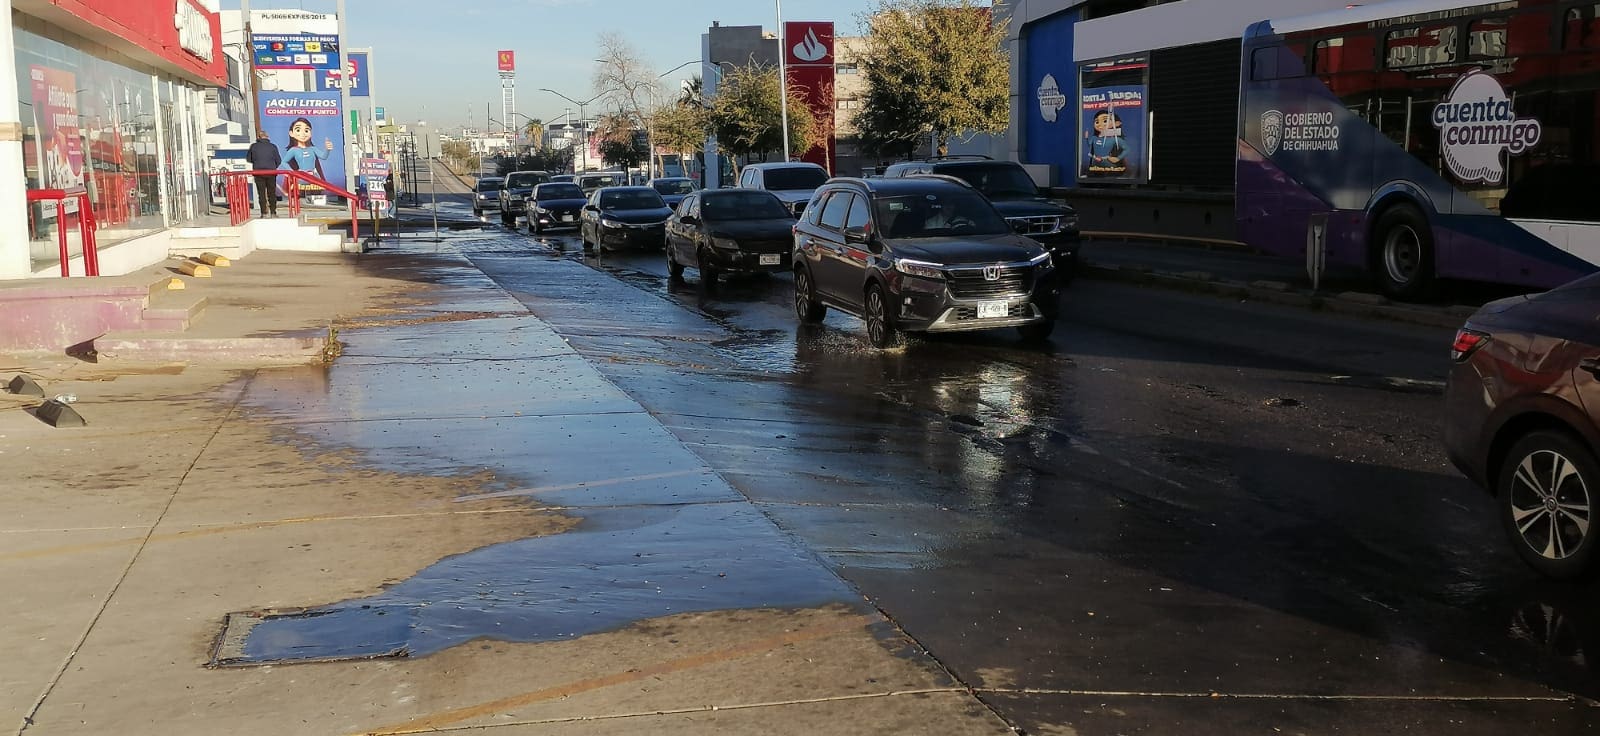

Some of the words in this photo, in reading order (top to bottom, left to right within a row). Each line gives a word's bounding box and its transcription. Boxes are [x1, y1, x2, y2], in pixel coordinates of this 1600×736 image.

[266, 98, 298, 108] ¡AQUÍ
[300, 99, 337, 107] LITROS
[1285, 112, 1333, 126] GOBIERNO
[1284, 127, 1301, 139] DEL
[1303, 126, 1339, 139] ESTADO
[1446, 123, 1539, 151] conmigo
[1283, 141, 1293, 151] DE
[1294, 140, 1339, 151] CHIHUAHUA
